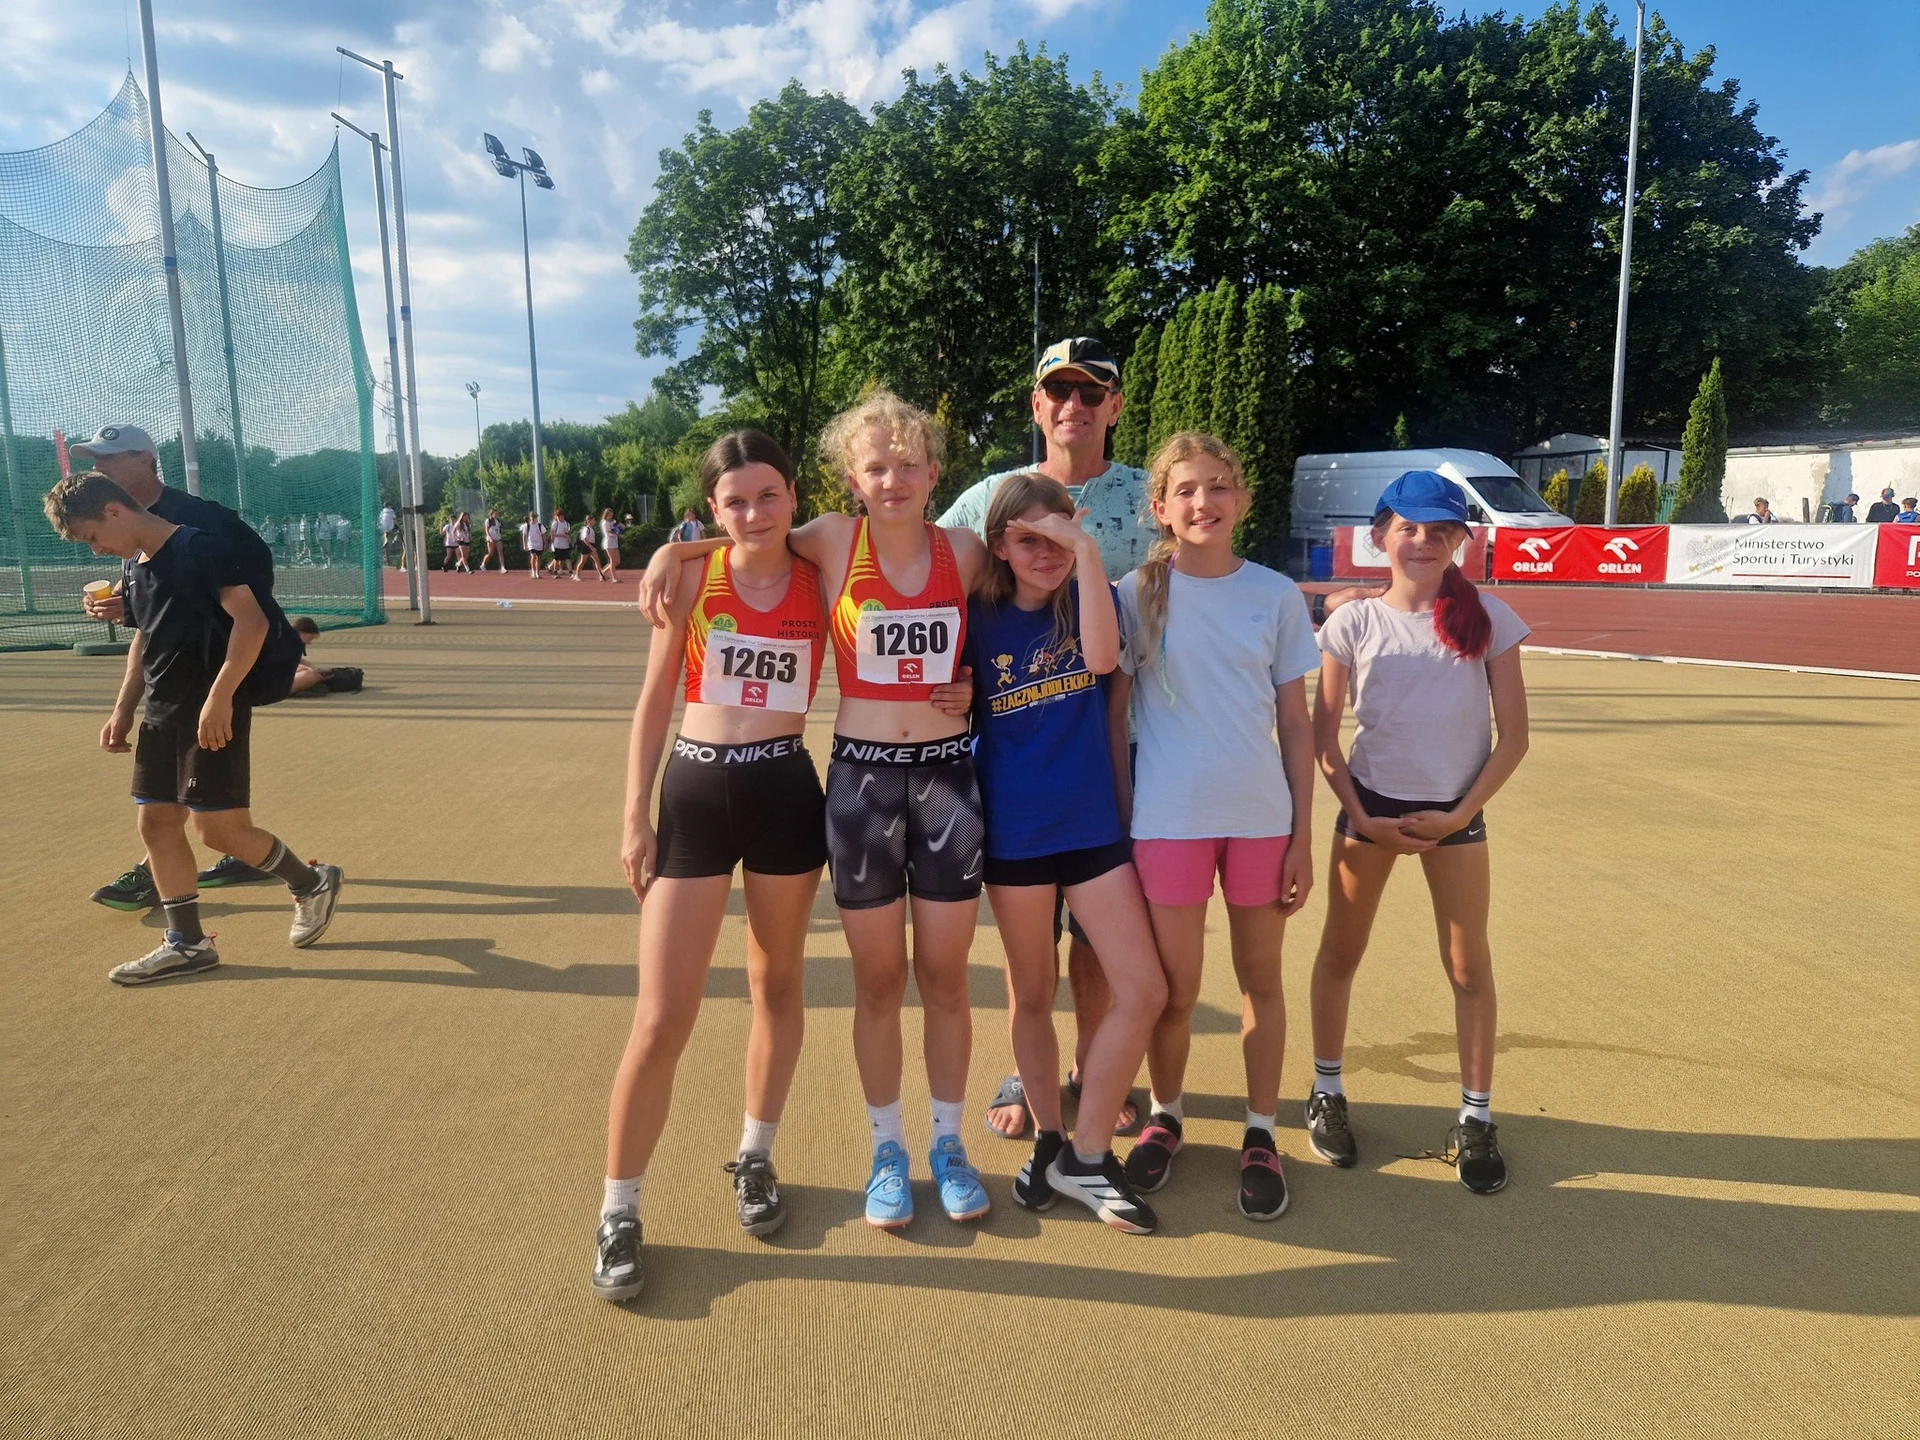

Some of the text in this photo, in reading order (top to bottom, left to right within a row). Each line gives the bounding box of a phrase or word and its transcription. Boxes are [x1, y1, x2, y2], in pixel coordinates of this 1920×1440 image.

[1734, 538, 1825, 550] Ministerstwo
[1732, 553, 1855, 567] Sportu i Turystyki
[1512, 561, 1554, 573] ORLEN
[1597, 562, 1642, 574] ORLEN
[929, 597, 960, 609] PROSTE
[781, 619, 818, 629] PROSTE
[777, 630, 820, 640] HISTORIE
[870, 620, 949, 656] 1260
[720, 645, 798, 684] 1263
[673, 739, 717, 763] PRO
[724, 740, 790, 764] NIKE
[841, 742, 917, 763] NIKE
[919, 736, 971, 762] PRO
[1247, 1150, 1272, 1165] NIKE
